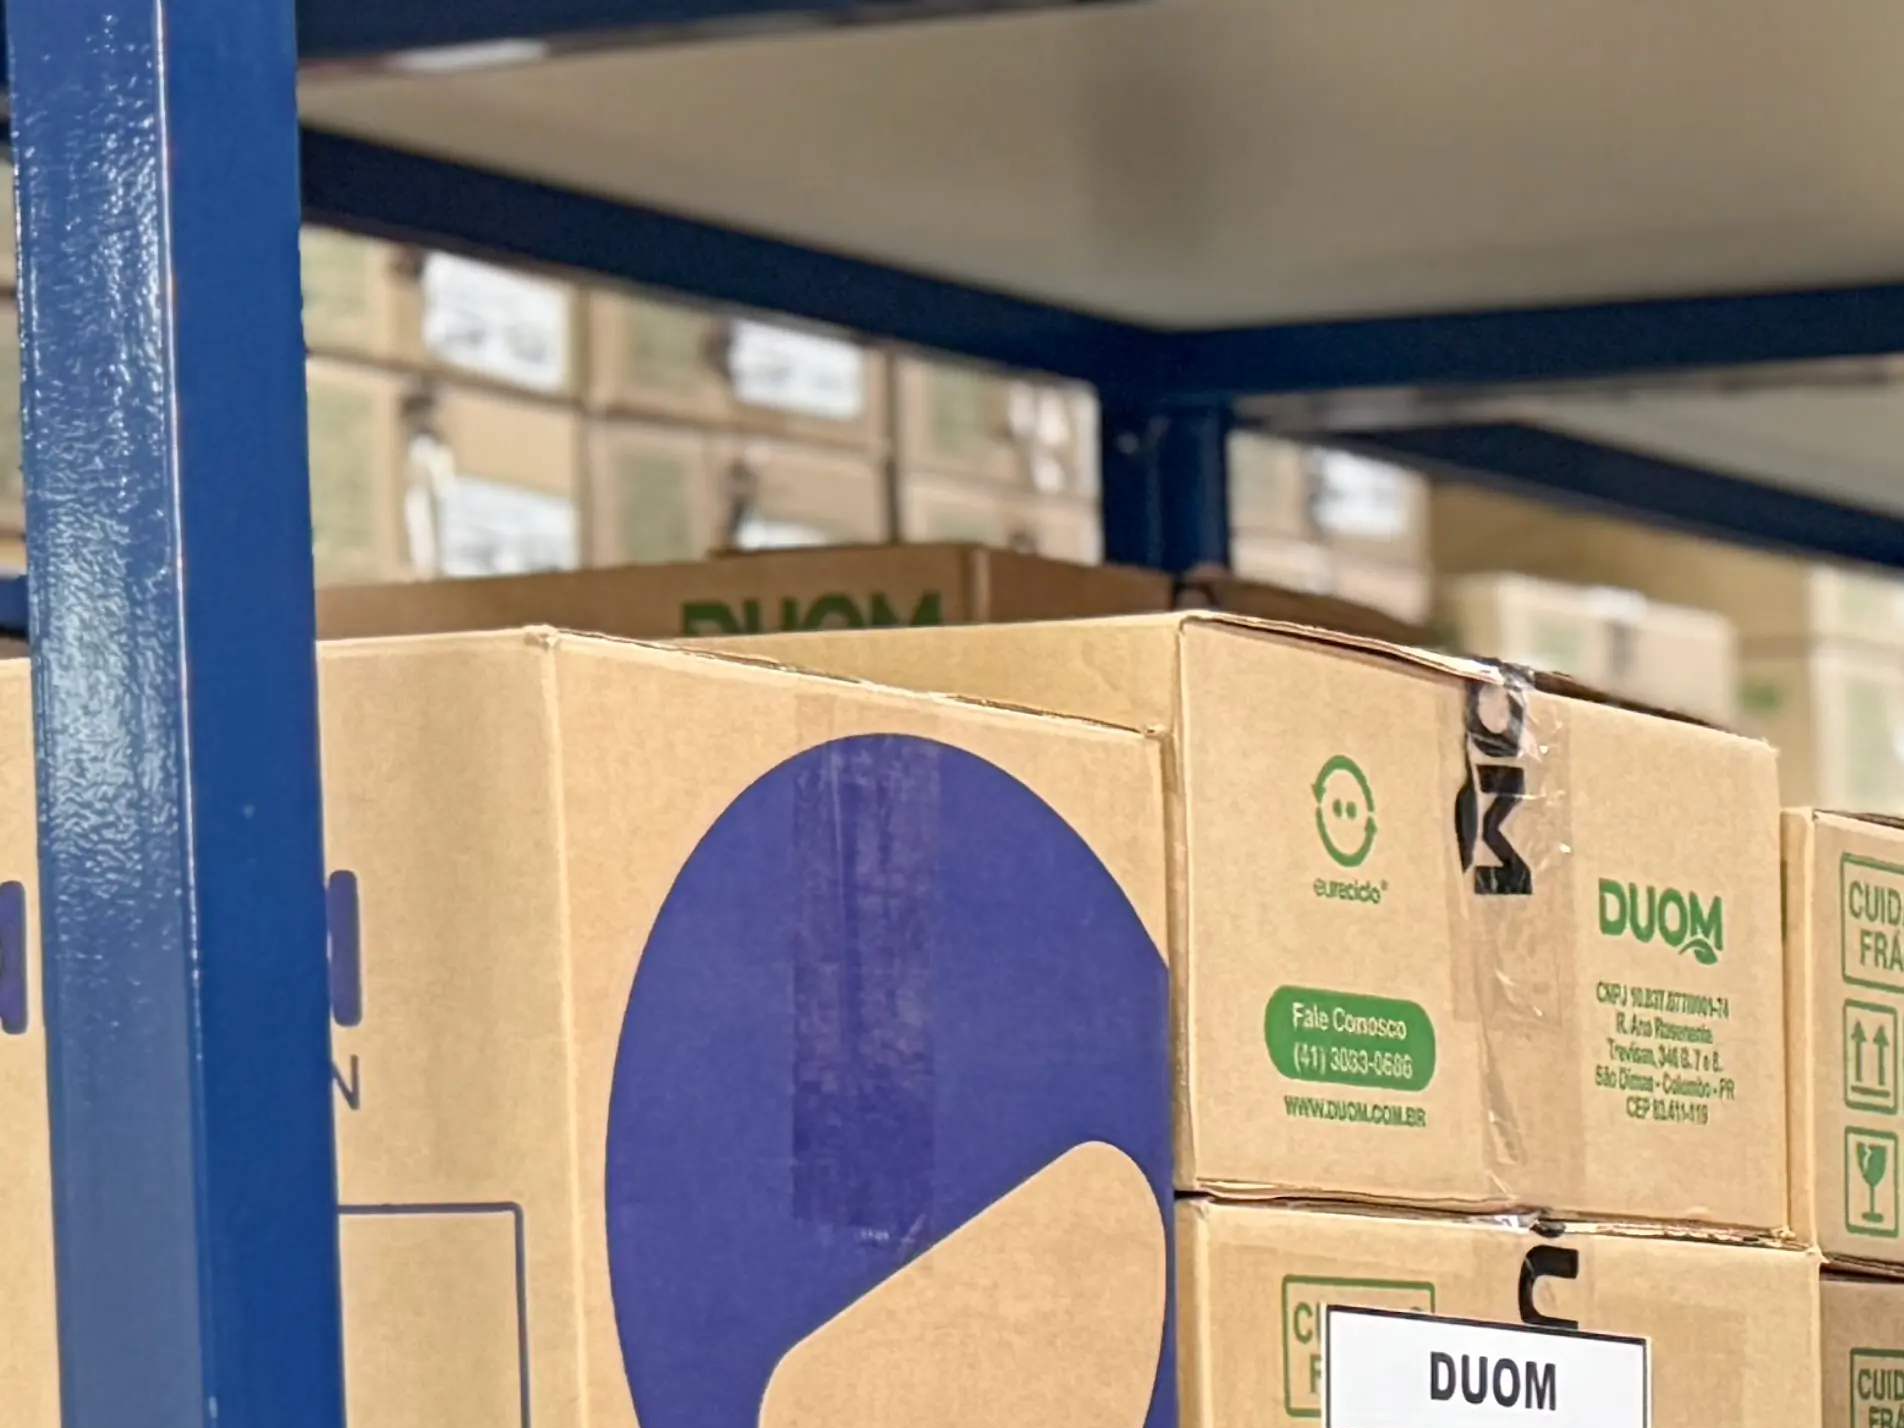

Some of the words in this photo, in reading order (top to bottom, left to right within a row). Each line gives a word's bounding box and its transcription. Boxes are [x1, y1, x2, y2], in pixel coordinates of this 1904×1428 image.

[1598, 877, 1724, 962] DUOM
[1291, 1002, 1330, 1033] Fale
[1333, 1006, 1407, 1041] Conosco
[1293, 1043, 1327, 1076] (41)
[1283, 1095, 1428, 1129] WWW.DUOM.COM.BR
[1430, 1351, 1556, 1411] DUOM
